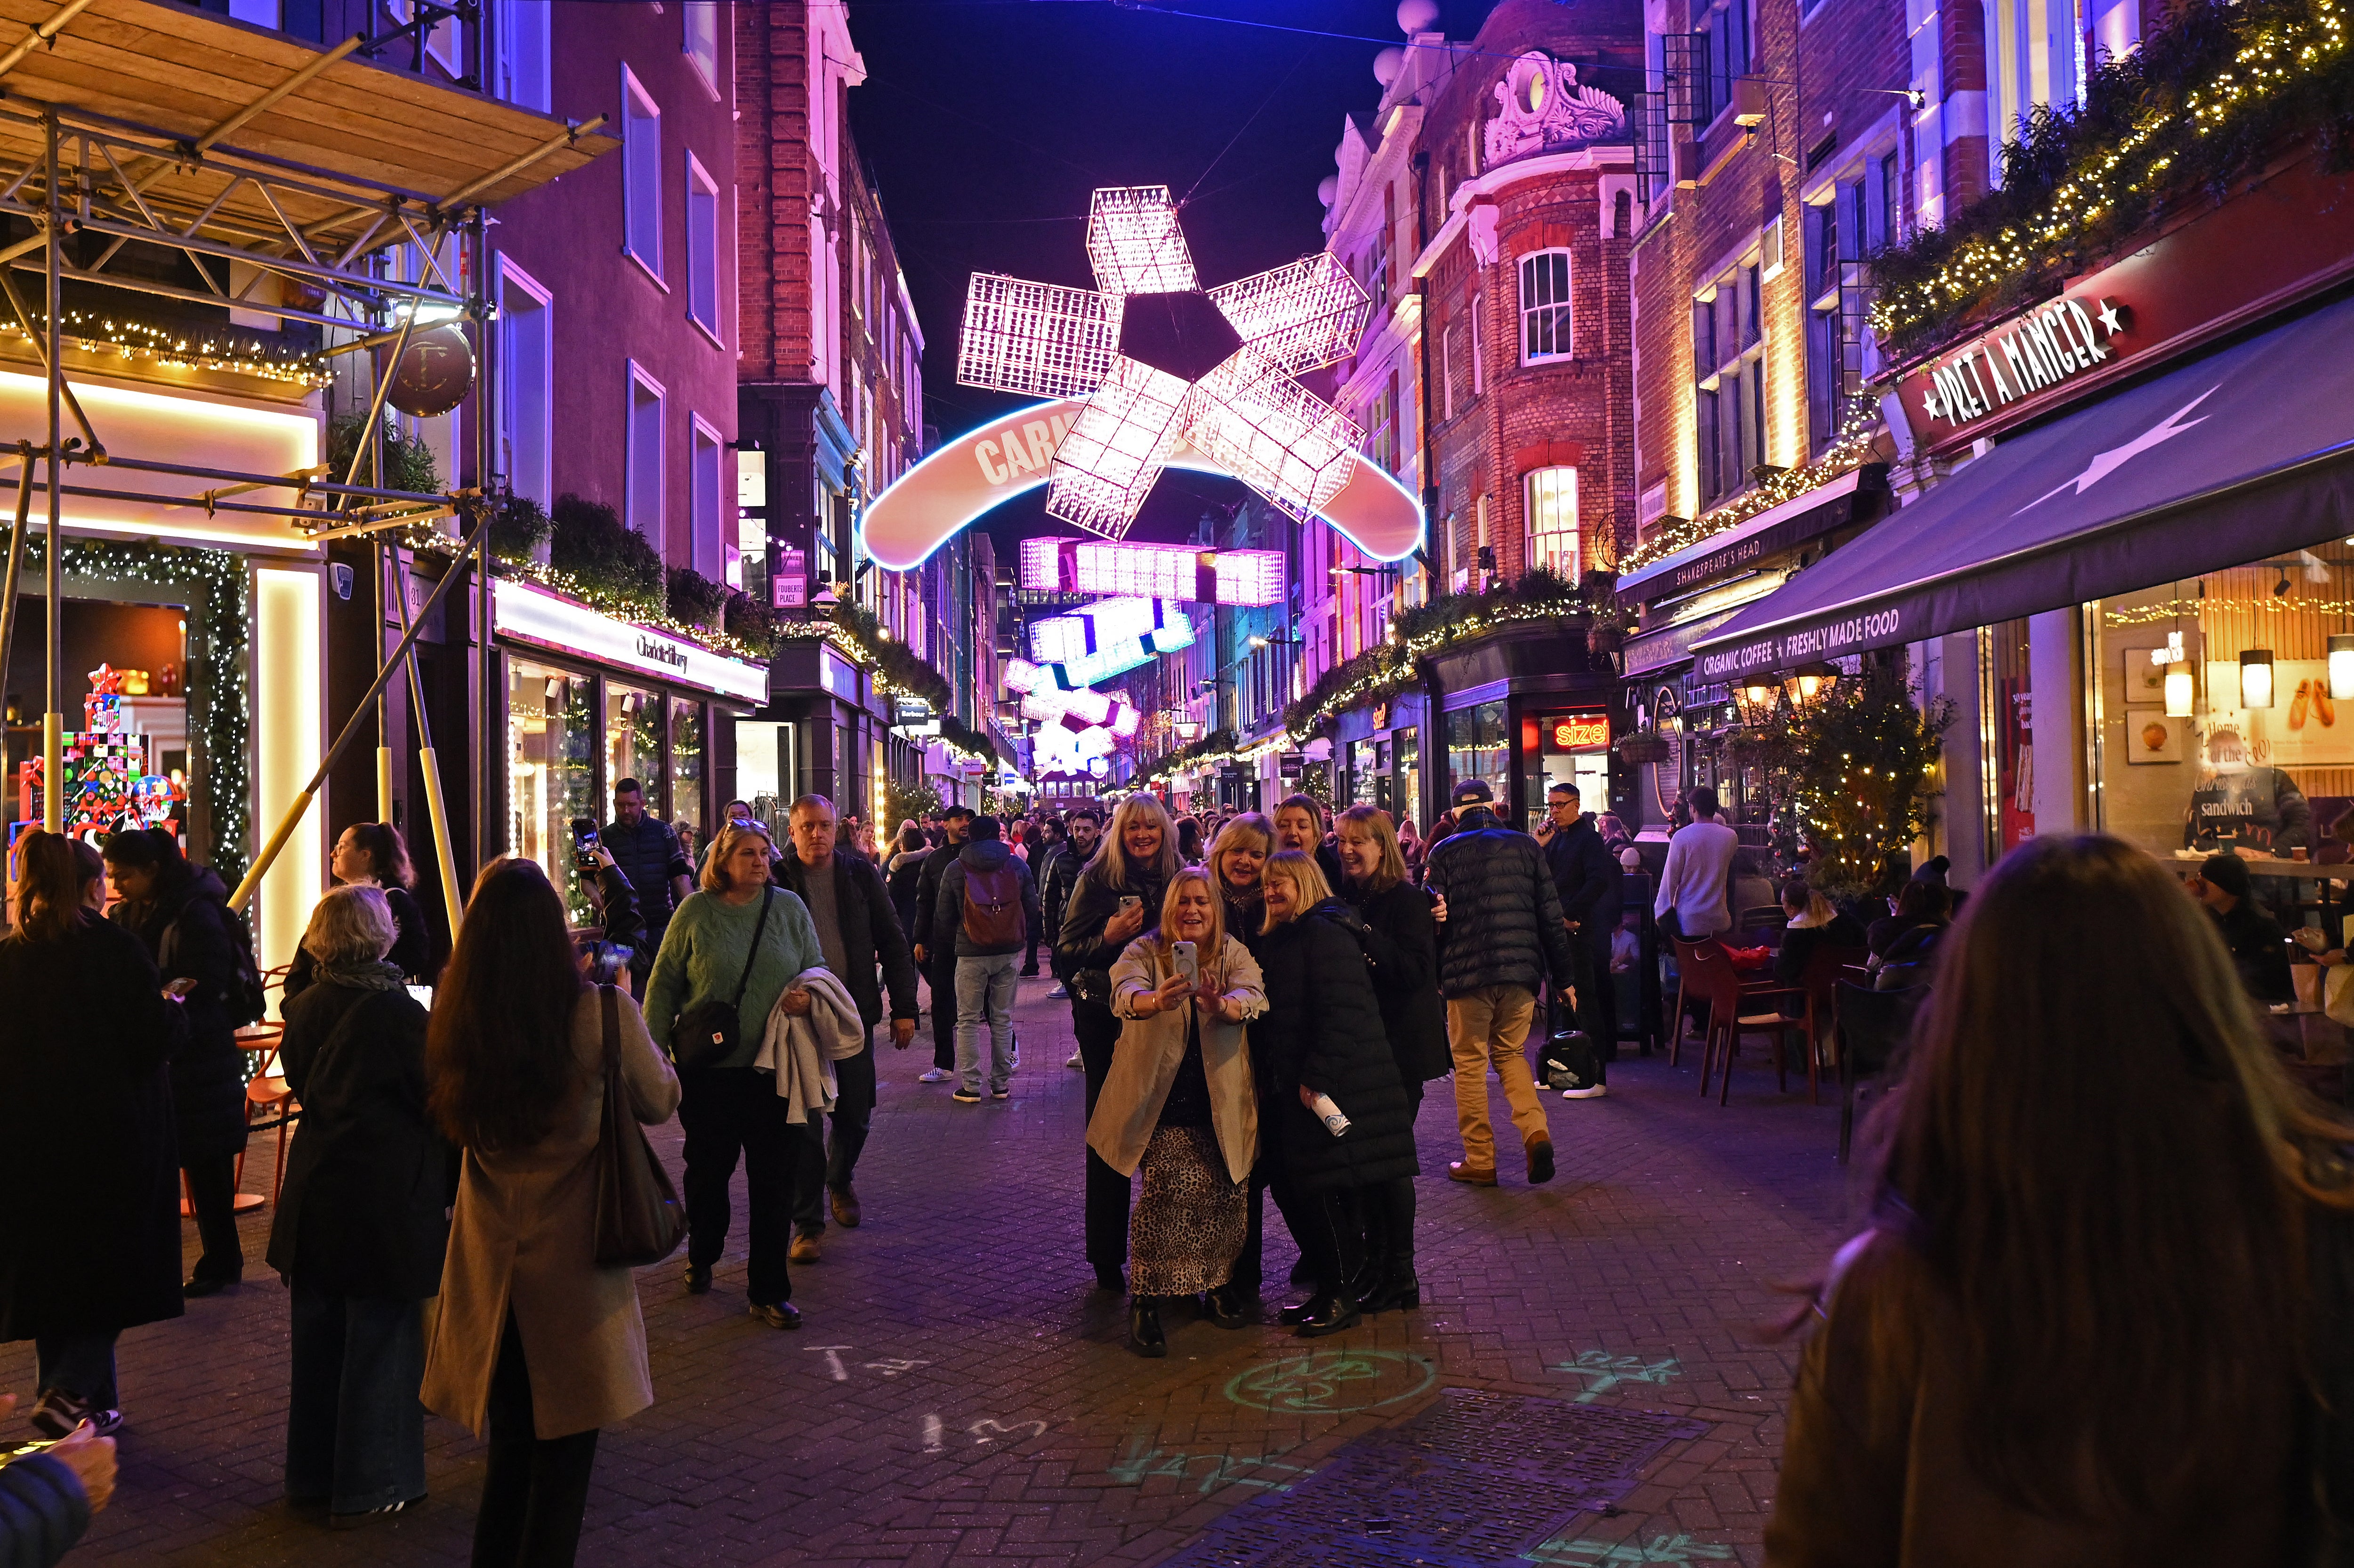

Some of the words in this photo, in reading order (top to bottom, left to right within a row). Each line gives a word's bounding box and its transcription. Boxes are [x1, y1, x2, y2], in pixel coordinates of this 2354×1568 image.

[1932, 351, 1991, 427] PRET
[1983, 346, 2014, 405] A
[1999, 299, 2107, 396] MANGER
[975, 413, 1074, 485] CARN
[1676, 551, 1735, 585] SHAKESPEARE'S
[1737, 540, 1760, 560] HEAD
[411, 587, 420, 606] 31
[778, 585, 803, 593] FOUBERTS
[780, 595, 796, 603] PLACE
[1703, 649, 1739, 675] ORGANIC
[1741, 641, 1772, 667] COFFEE
[1786, 627, 1829, 658] FRESHLY
[1829, 620, 1863, 648] MADE
[1865, 608, 1899, 639] FOOD
[1556, 719, 1607, 746] size
[2208, 721, 2240, 739] Home
[2224, 747, 2242, 762] the
[2201, 798, 2253, 818] sandwich
